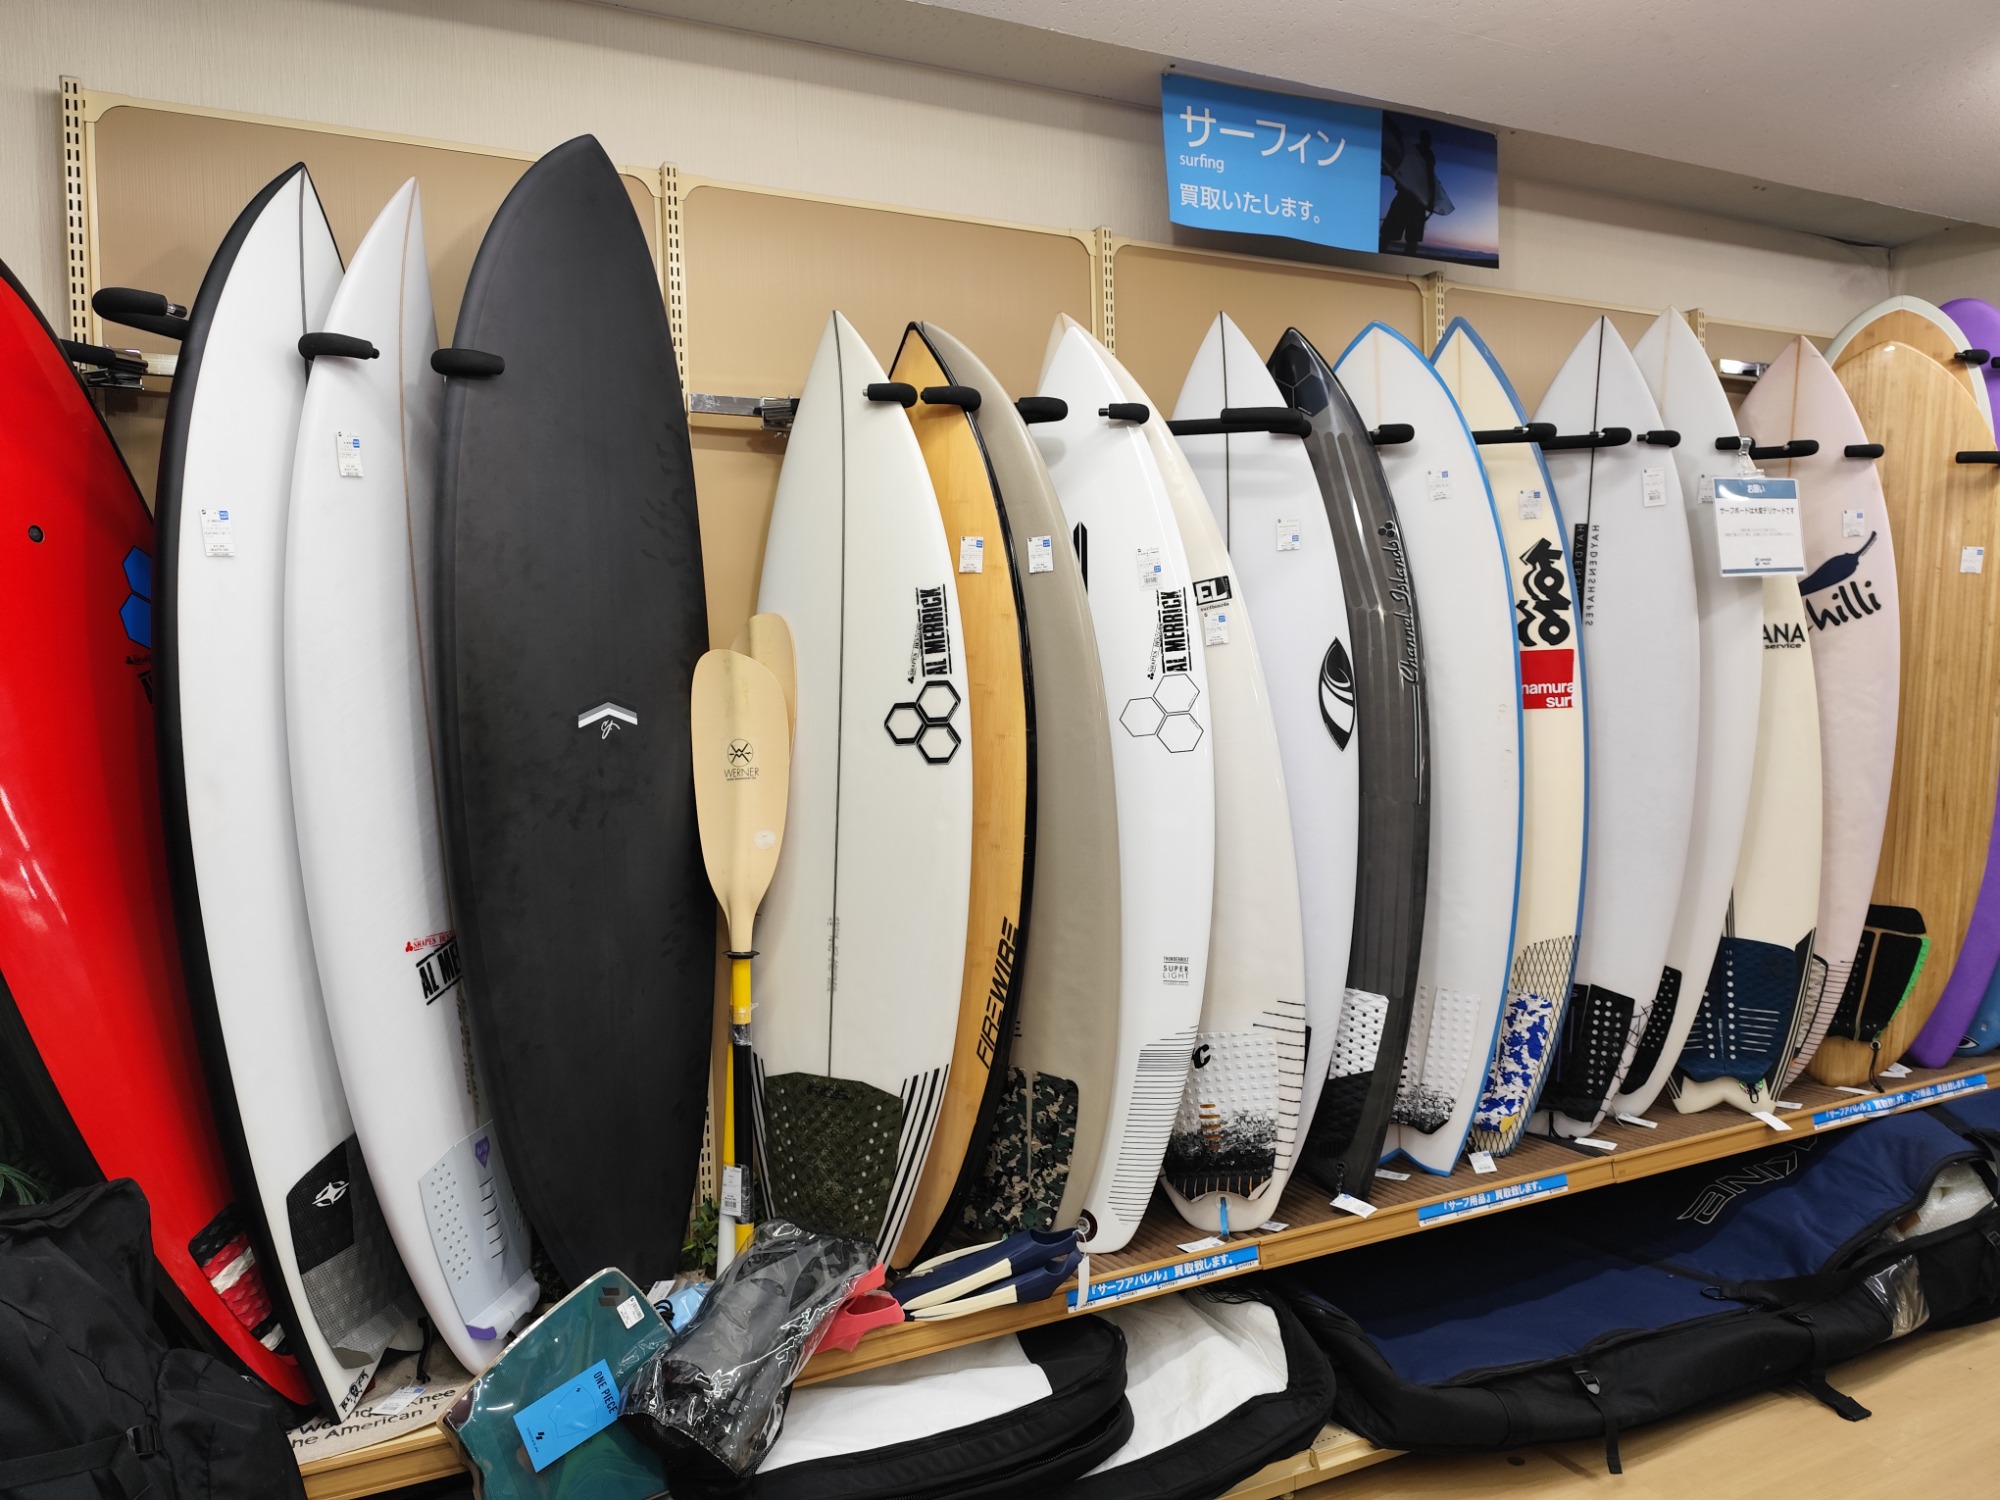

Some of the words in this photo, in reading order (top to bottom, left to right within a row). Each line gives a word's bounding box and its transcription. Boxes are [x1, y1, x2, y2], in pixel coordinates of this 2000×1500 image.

[1180, 106, 1345, 166] サーフィン
[1179, 153, 1225, 173] surfing
[1180, 183, 1321, 224] 買取いたします。
[1382, 539, 1411, 607] Islands
[919, 586, 947, 655] MERRICK
[1160, 589, 1188, 653] MERRICK
[1805, 580, 1882, 631] hilli
[925, 658, 948, 675] AL
[1165, 656, 1188, 672] AL
[1394, 611, 1419, 684] Channel
[723, 767, 760, 778] WERNER
[418, 961, 440, 999] AL
[436, 940, 461, 985] ME
[976, 915, 1019, 1070] FIREWIRE
[1174, 1253, 1233, 1277] 買取致します。
[593, 1369, 608, 1390] ONE
[600, 1387, 619, 1415] PIECE
[324, 1410, 423, 1440] American
